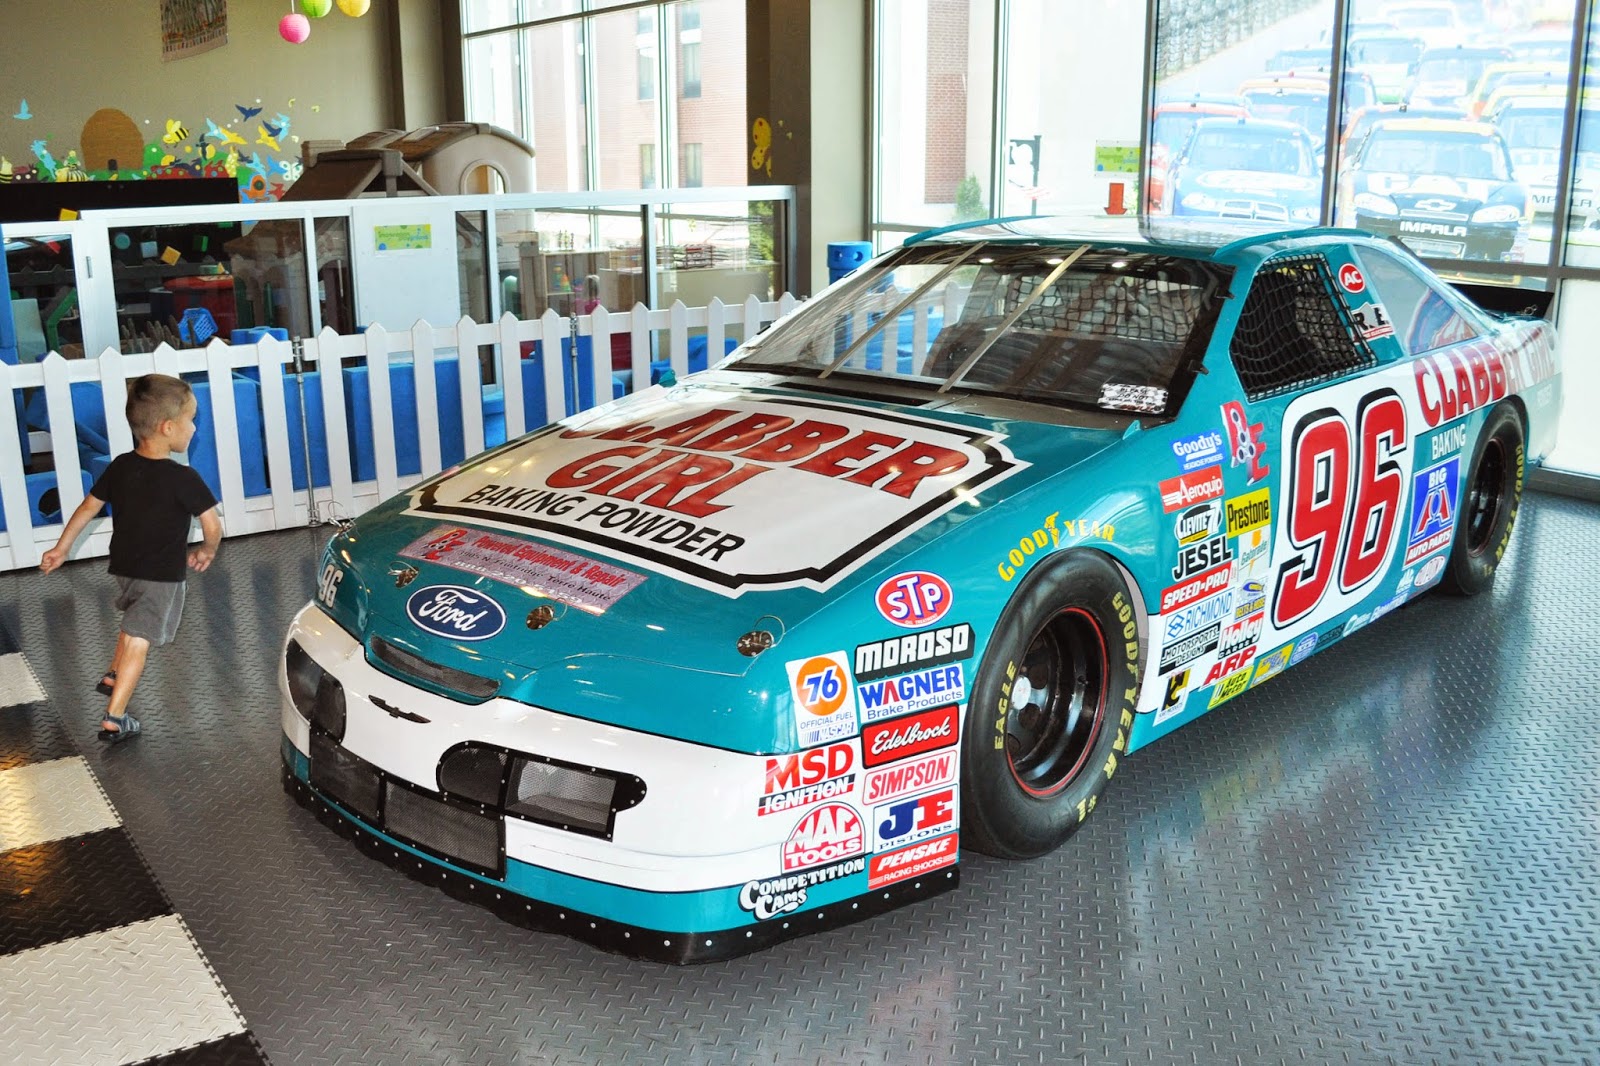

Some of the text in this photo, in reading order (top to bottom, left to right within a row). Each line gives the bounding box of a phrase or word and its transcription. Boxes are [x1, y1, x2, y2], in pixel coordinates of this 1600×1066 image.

[1400, 221, 1468, 237] IMPALA
[1344, 271, 1361, 286] AC
[1173, 432, 1222, 459] Goody's
[1431, 423, 1467, 460] BAKING
[546, 445, 774, 518] GIRL
[1179, 476, 1223, 505] Aeroquip
[1429, 467, 1447, 488] BIG
[460, 484, 746, 563] BAKING POWDER
[1227, 499, 1269, 533] Prestone
[1271, 387, 1408, 631] 96
[471, 535, 627, 588] Powered Equipment & Repair
[1174, 535, 1232, 580] JESEL
[1406, 530, 1451, 562] AUTO PARTS
[318, 564, 344, 608] 96
[547, 575, 575, 590] Terre
[576, 585, 612, 602] Haute
[886, 575, 943, 619] STP
[1163, 567, 1229, 610] SPEED-PRO
[417, 588, 489, 632] Ford
[1185, 592, 1233, 632] RICHMOND
[855, 624, 969, 675] MOROSO
[1164, 627, 1218, 661] MOTORSPORTS
[1222, 616, 1263, 649] Holley
[802, 665, 839, 703] 76
[1203, 645, 1257, 686] ARP
[1225, 672, 1247, 688] Auto
[859, 665, 961, 710] WAGNER
[867, 690, 963, 720] Brake Products
[994, 660, 1018, 751] EAGLE
[800, 711, 854, 729] OFFICIAL FUEL
[870, 716, 952, 756] Edelbrock
[765, 744, 854, 795] MSD
[868, 755, 951, 800] SIMPSON
[762, 776, 851, 815] IGNITION
[879, 789, 953, 841] JE
[793, 804, 861, 855] MAC
[878, 822, 952, 851] PISTONS
[786, 837, 862, 872] TOOLS
[876, 836, 953, 872] PENSKE
[883, 856, 944, 882] RACING SHOCKS
[740, 857, 866, 905] COMPETITION
[753, 886, 808, 921] CAMS
